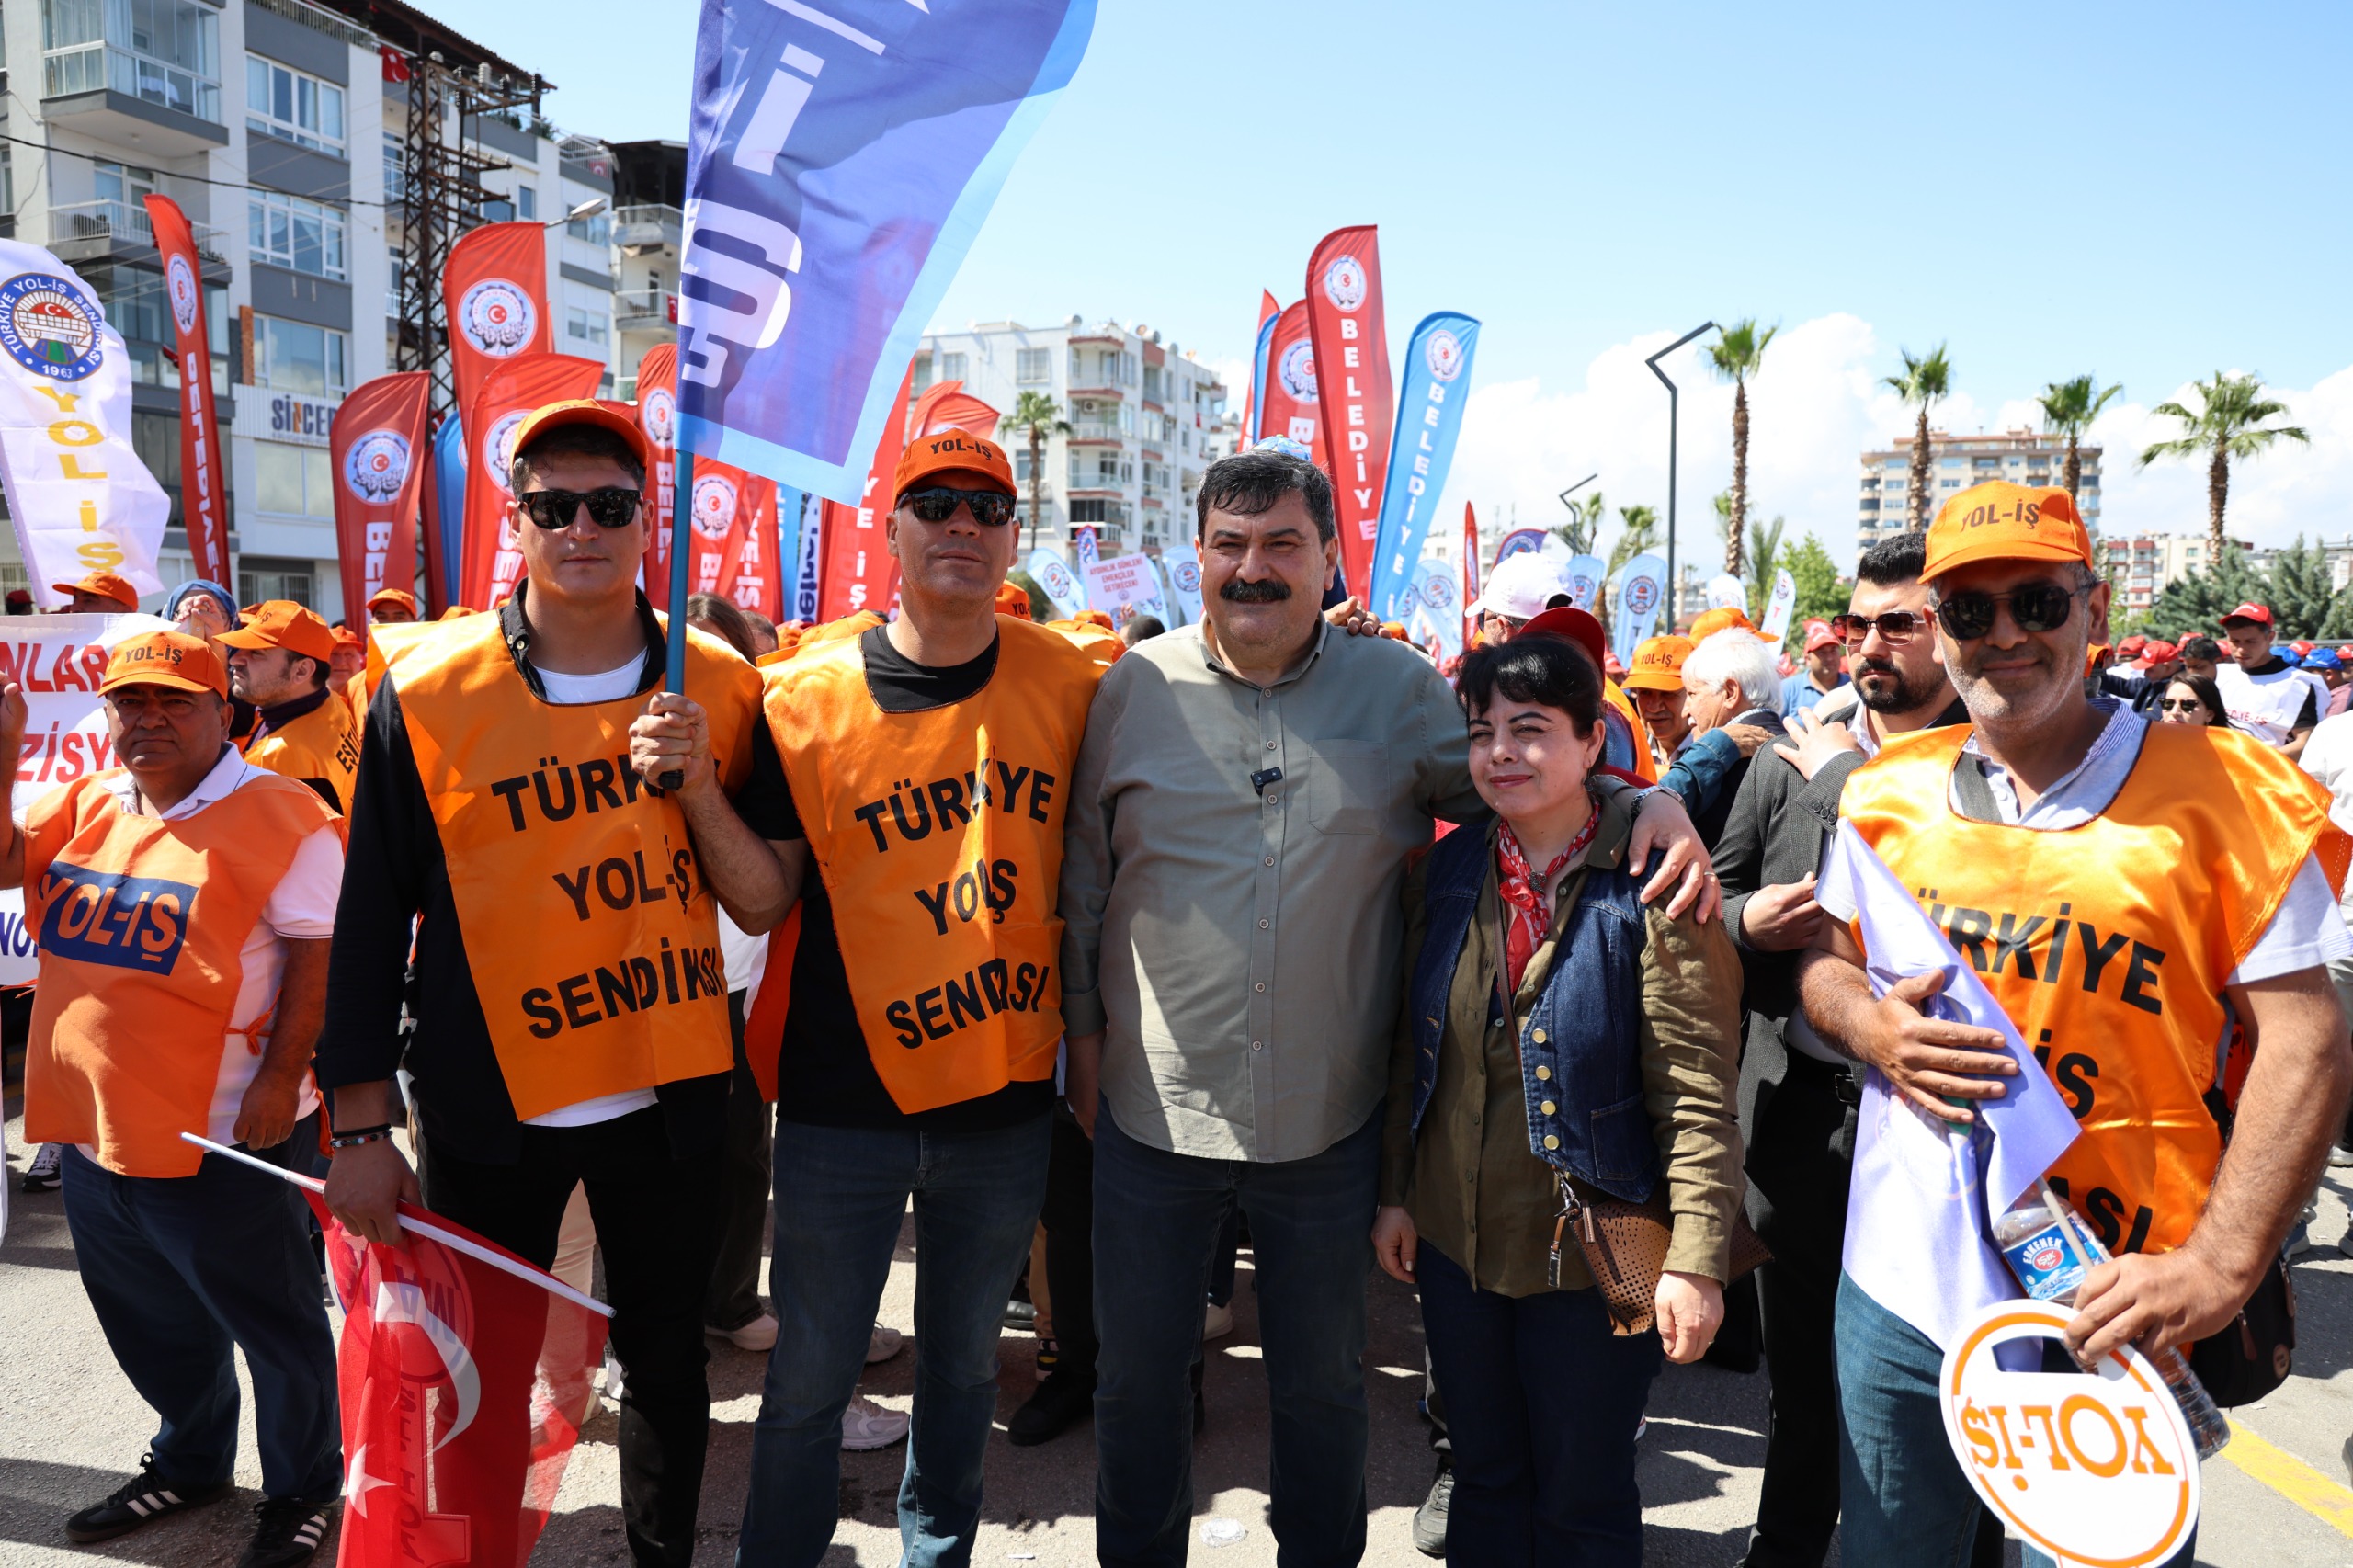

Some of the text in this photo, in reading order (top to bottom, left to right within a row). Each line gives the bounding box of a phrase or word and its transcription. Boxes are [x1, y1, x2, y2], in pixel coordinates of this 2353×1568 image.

[42, 364, 73, 379] 1963
[930, 438, 993, 461] YOL-İŞ
[1340, 318, 1377, 541] BELEDİYE
[1392, 382, 1445, 575] BELEDİYE
[1961, 498, 2041, 532] YOL-İŞ
[125, 644, 183, 666] YOL-İŞ
[1641, 652, 1673, 668] YOL-İŞ
[491, 754, 665, 832] TÜRK
[854, 745, 1055, 853] TÜRKYE
[38, 874, 180, 962] YOL-İŞ
[1917, 888, 2166, 1016] ÜRKİYE
[2022, 1236, 2063, 1264] ERKENEK
[1960, 1393, 2176, 1491] YOL-İŞ
